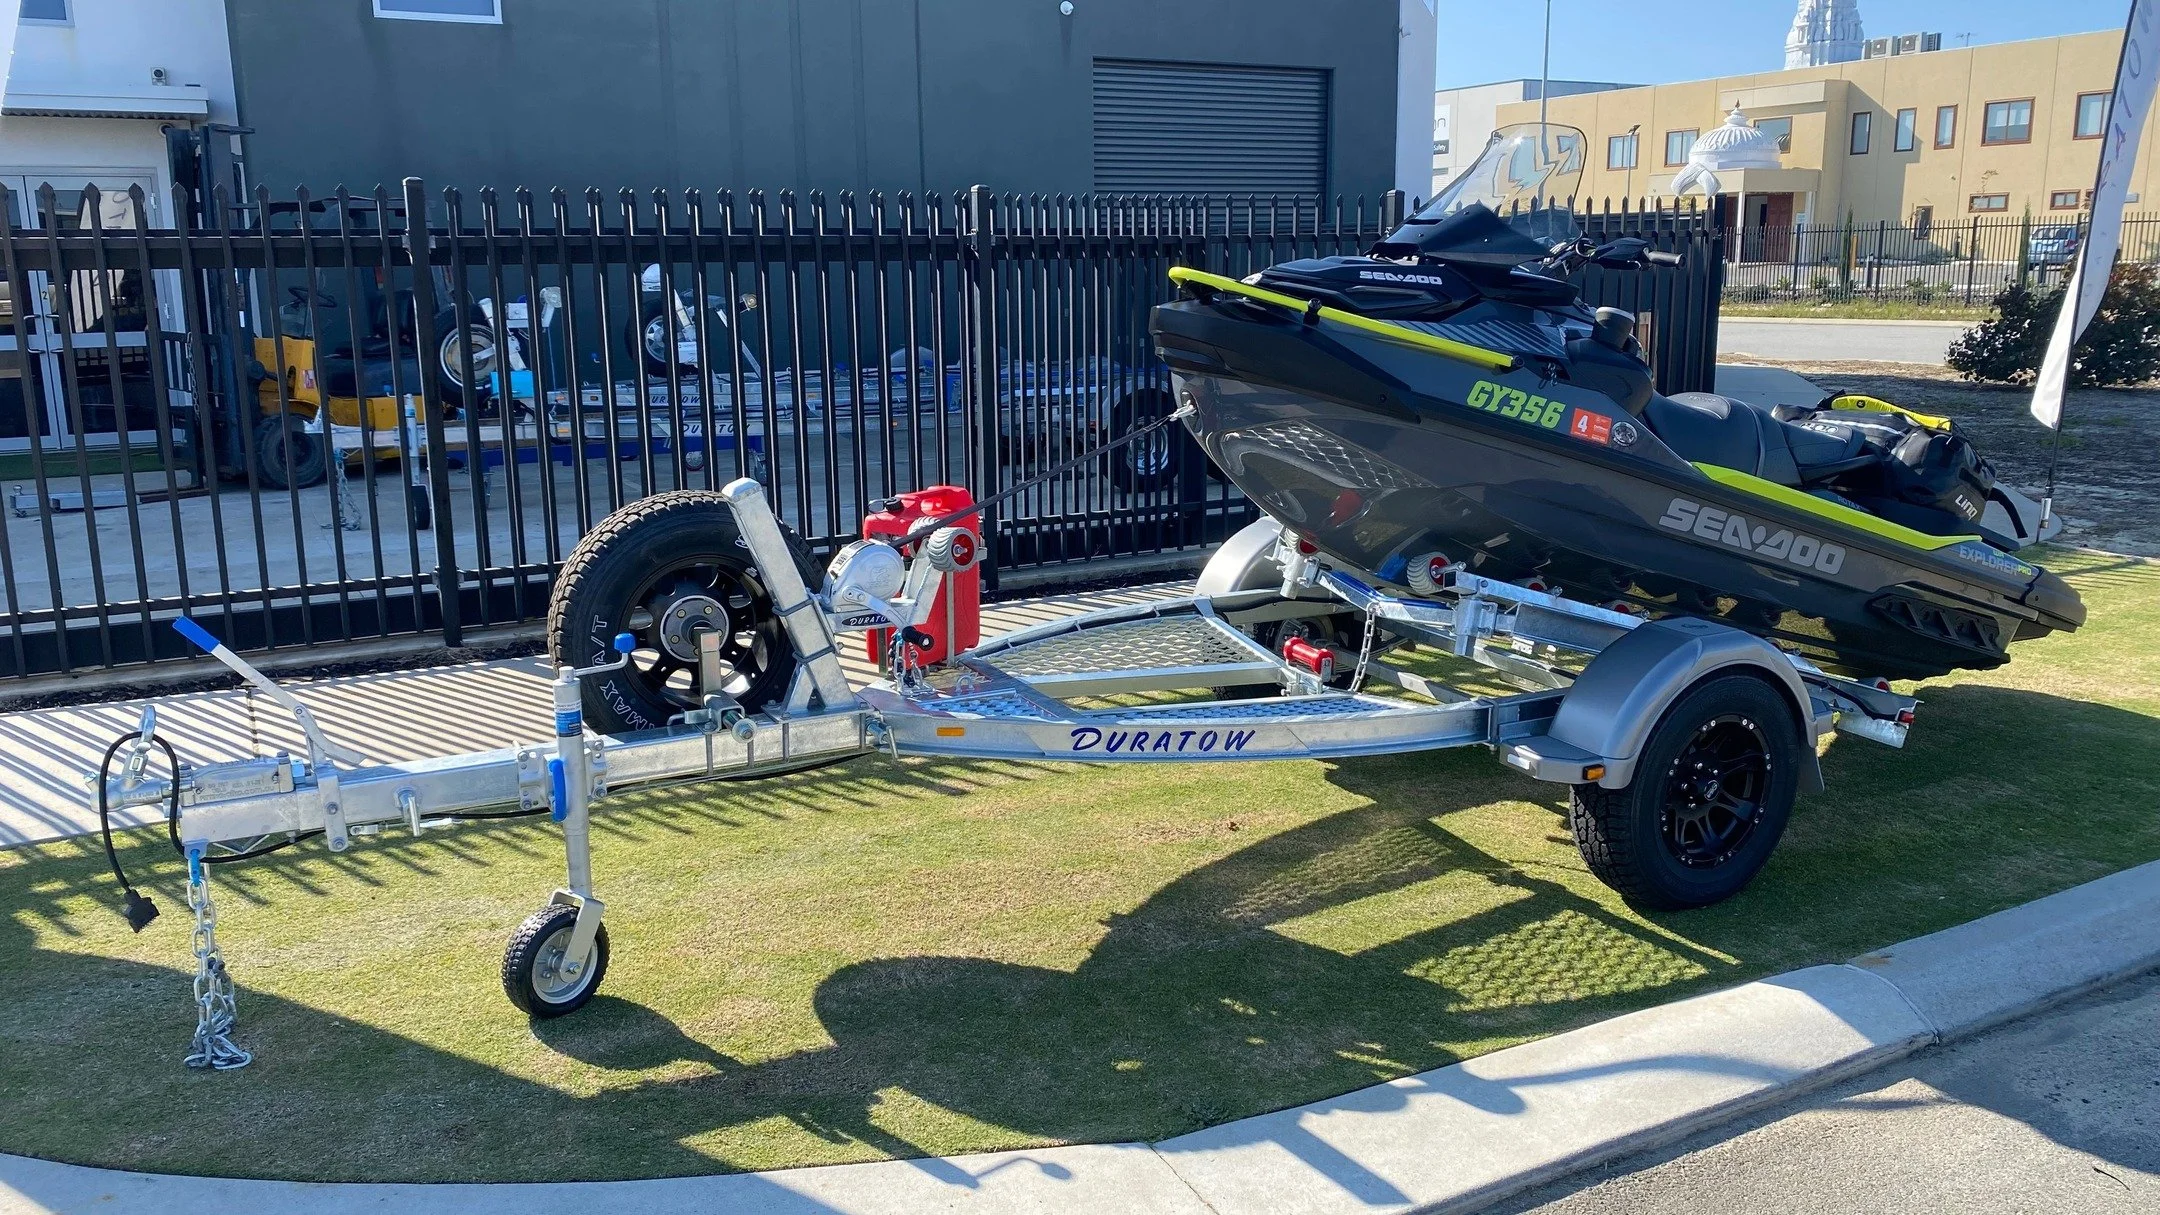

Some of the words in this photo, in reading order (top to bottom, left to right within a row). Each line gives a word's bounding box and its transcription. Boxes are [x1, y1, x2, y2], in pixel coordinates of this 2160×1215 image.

[1466, 379, 1567, 429] GY356
[1577, 414, 1589, 433] 4
[849, 615, 891, 626] DURATO
[1070, 727, 1256, 753] DURATOW
